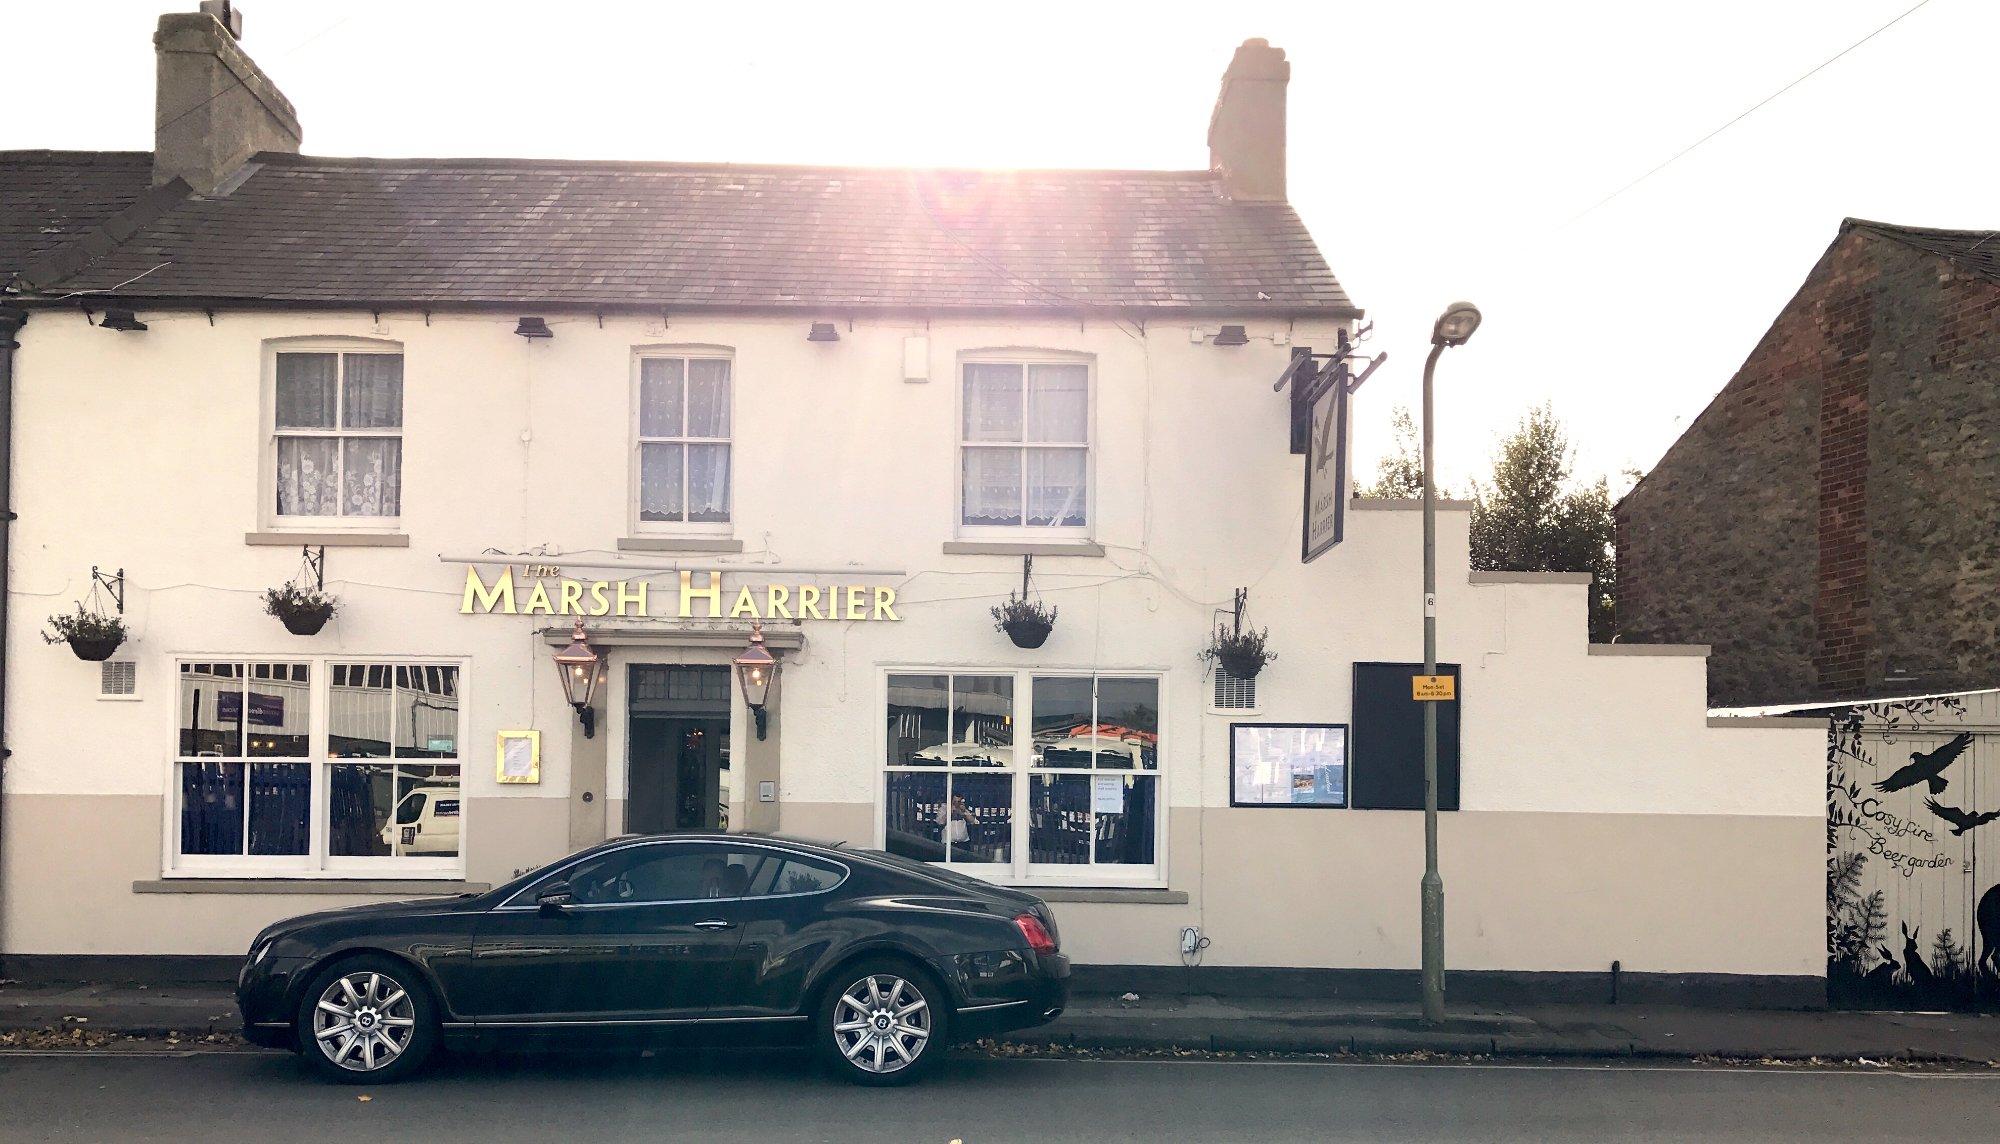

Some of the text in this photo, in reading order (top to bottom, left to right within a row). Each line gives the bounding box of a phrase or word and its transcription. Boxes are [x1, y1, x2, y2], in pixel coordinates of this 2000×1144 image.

[1314, 491, 1333, 516] MARSH
[1312, 514, 1334, 540] HARRIER
[459, 564, 902, 621] MARSH HARRIER
[1427, 597, 1434, 606] 6
[1868, 837, 1953, 877] Beer garden
